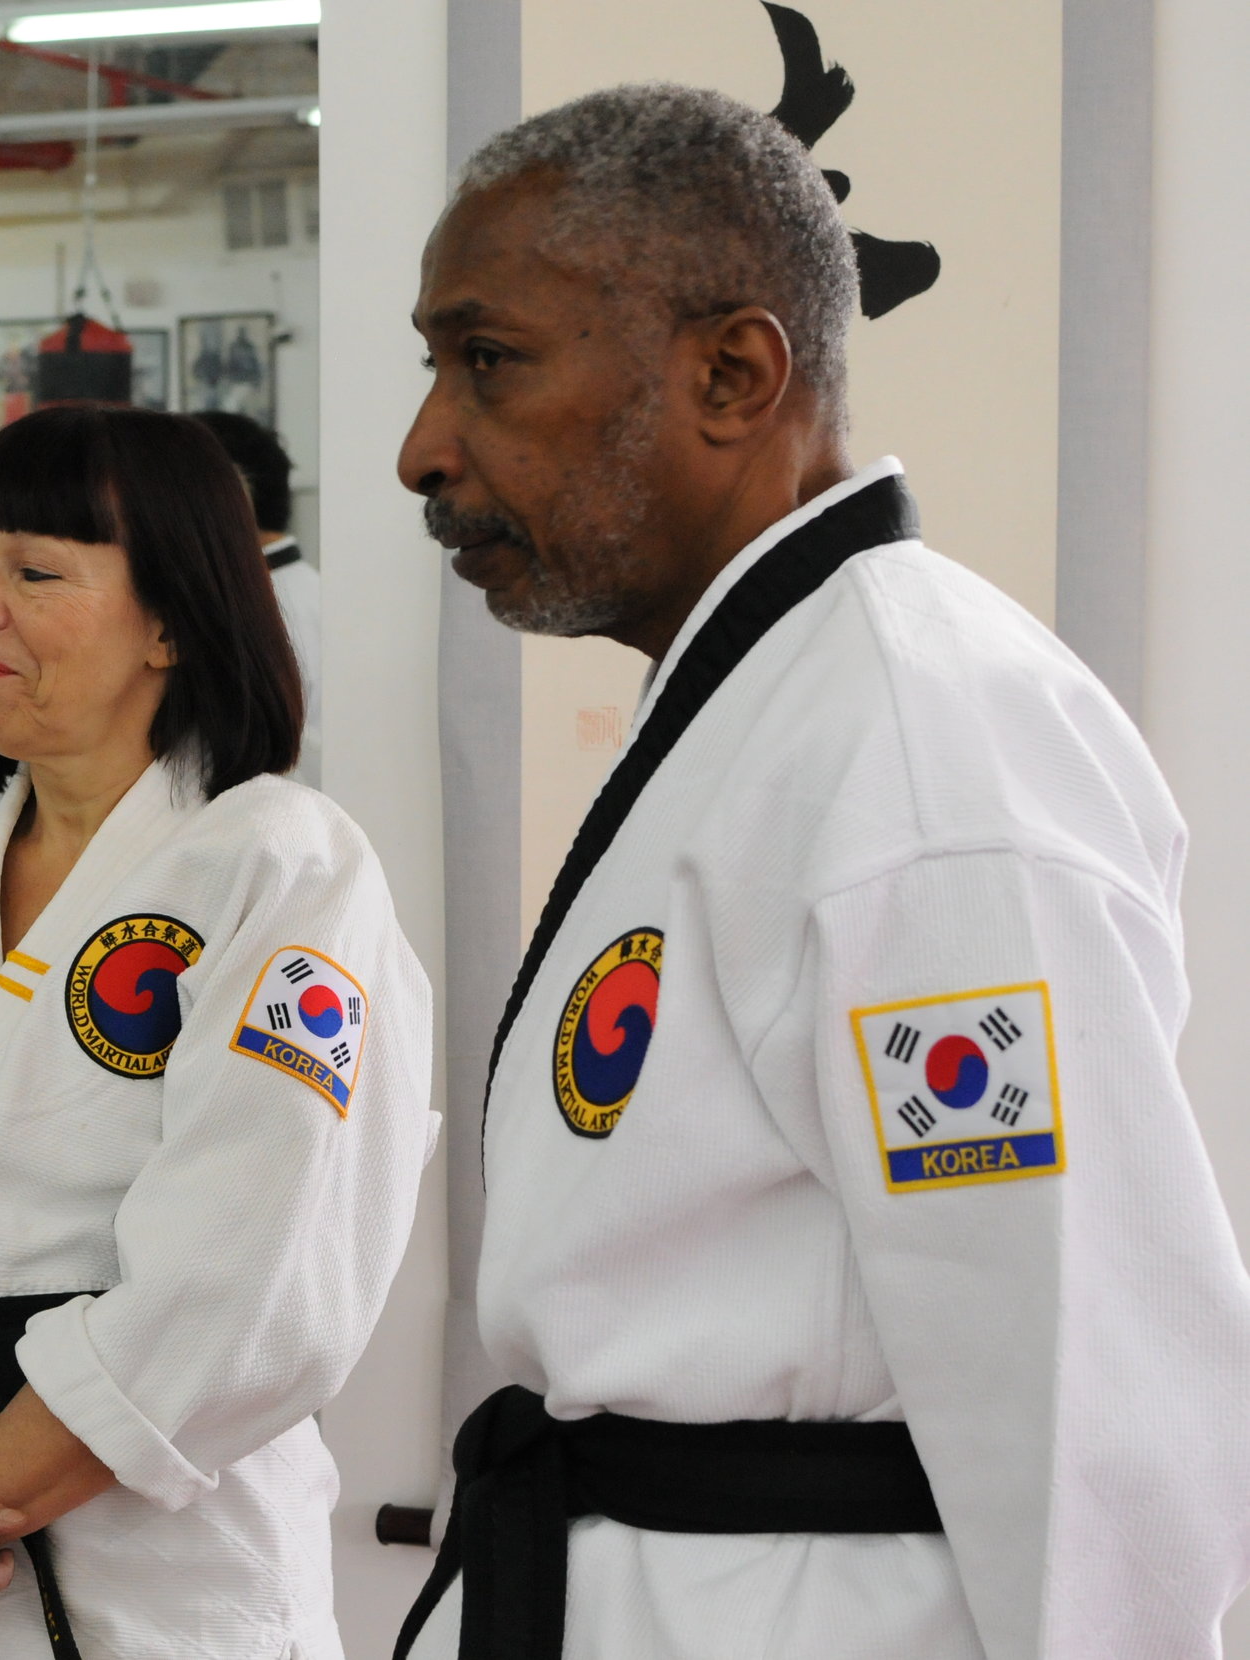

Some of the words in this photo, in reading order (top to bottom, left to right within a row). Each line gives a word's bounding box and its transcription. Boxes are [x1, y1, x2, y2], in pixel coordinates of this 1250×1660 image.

[71, 964, 93, 1028] WORLD
[561, 970, 598, 1046] WORLD
[81, 1028, 152, 1071] MARTIAL
[153, 1046, 173, 1069] AR
[263, 1038, 334, 1092] KOREA
[557, 1053, 586, 1127] MARTIAL
[921, 1141, 1021, 1177] KOREA
